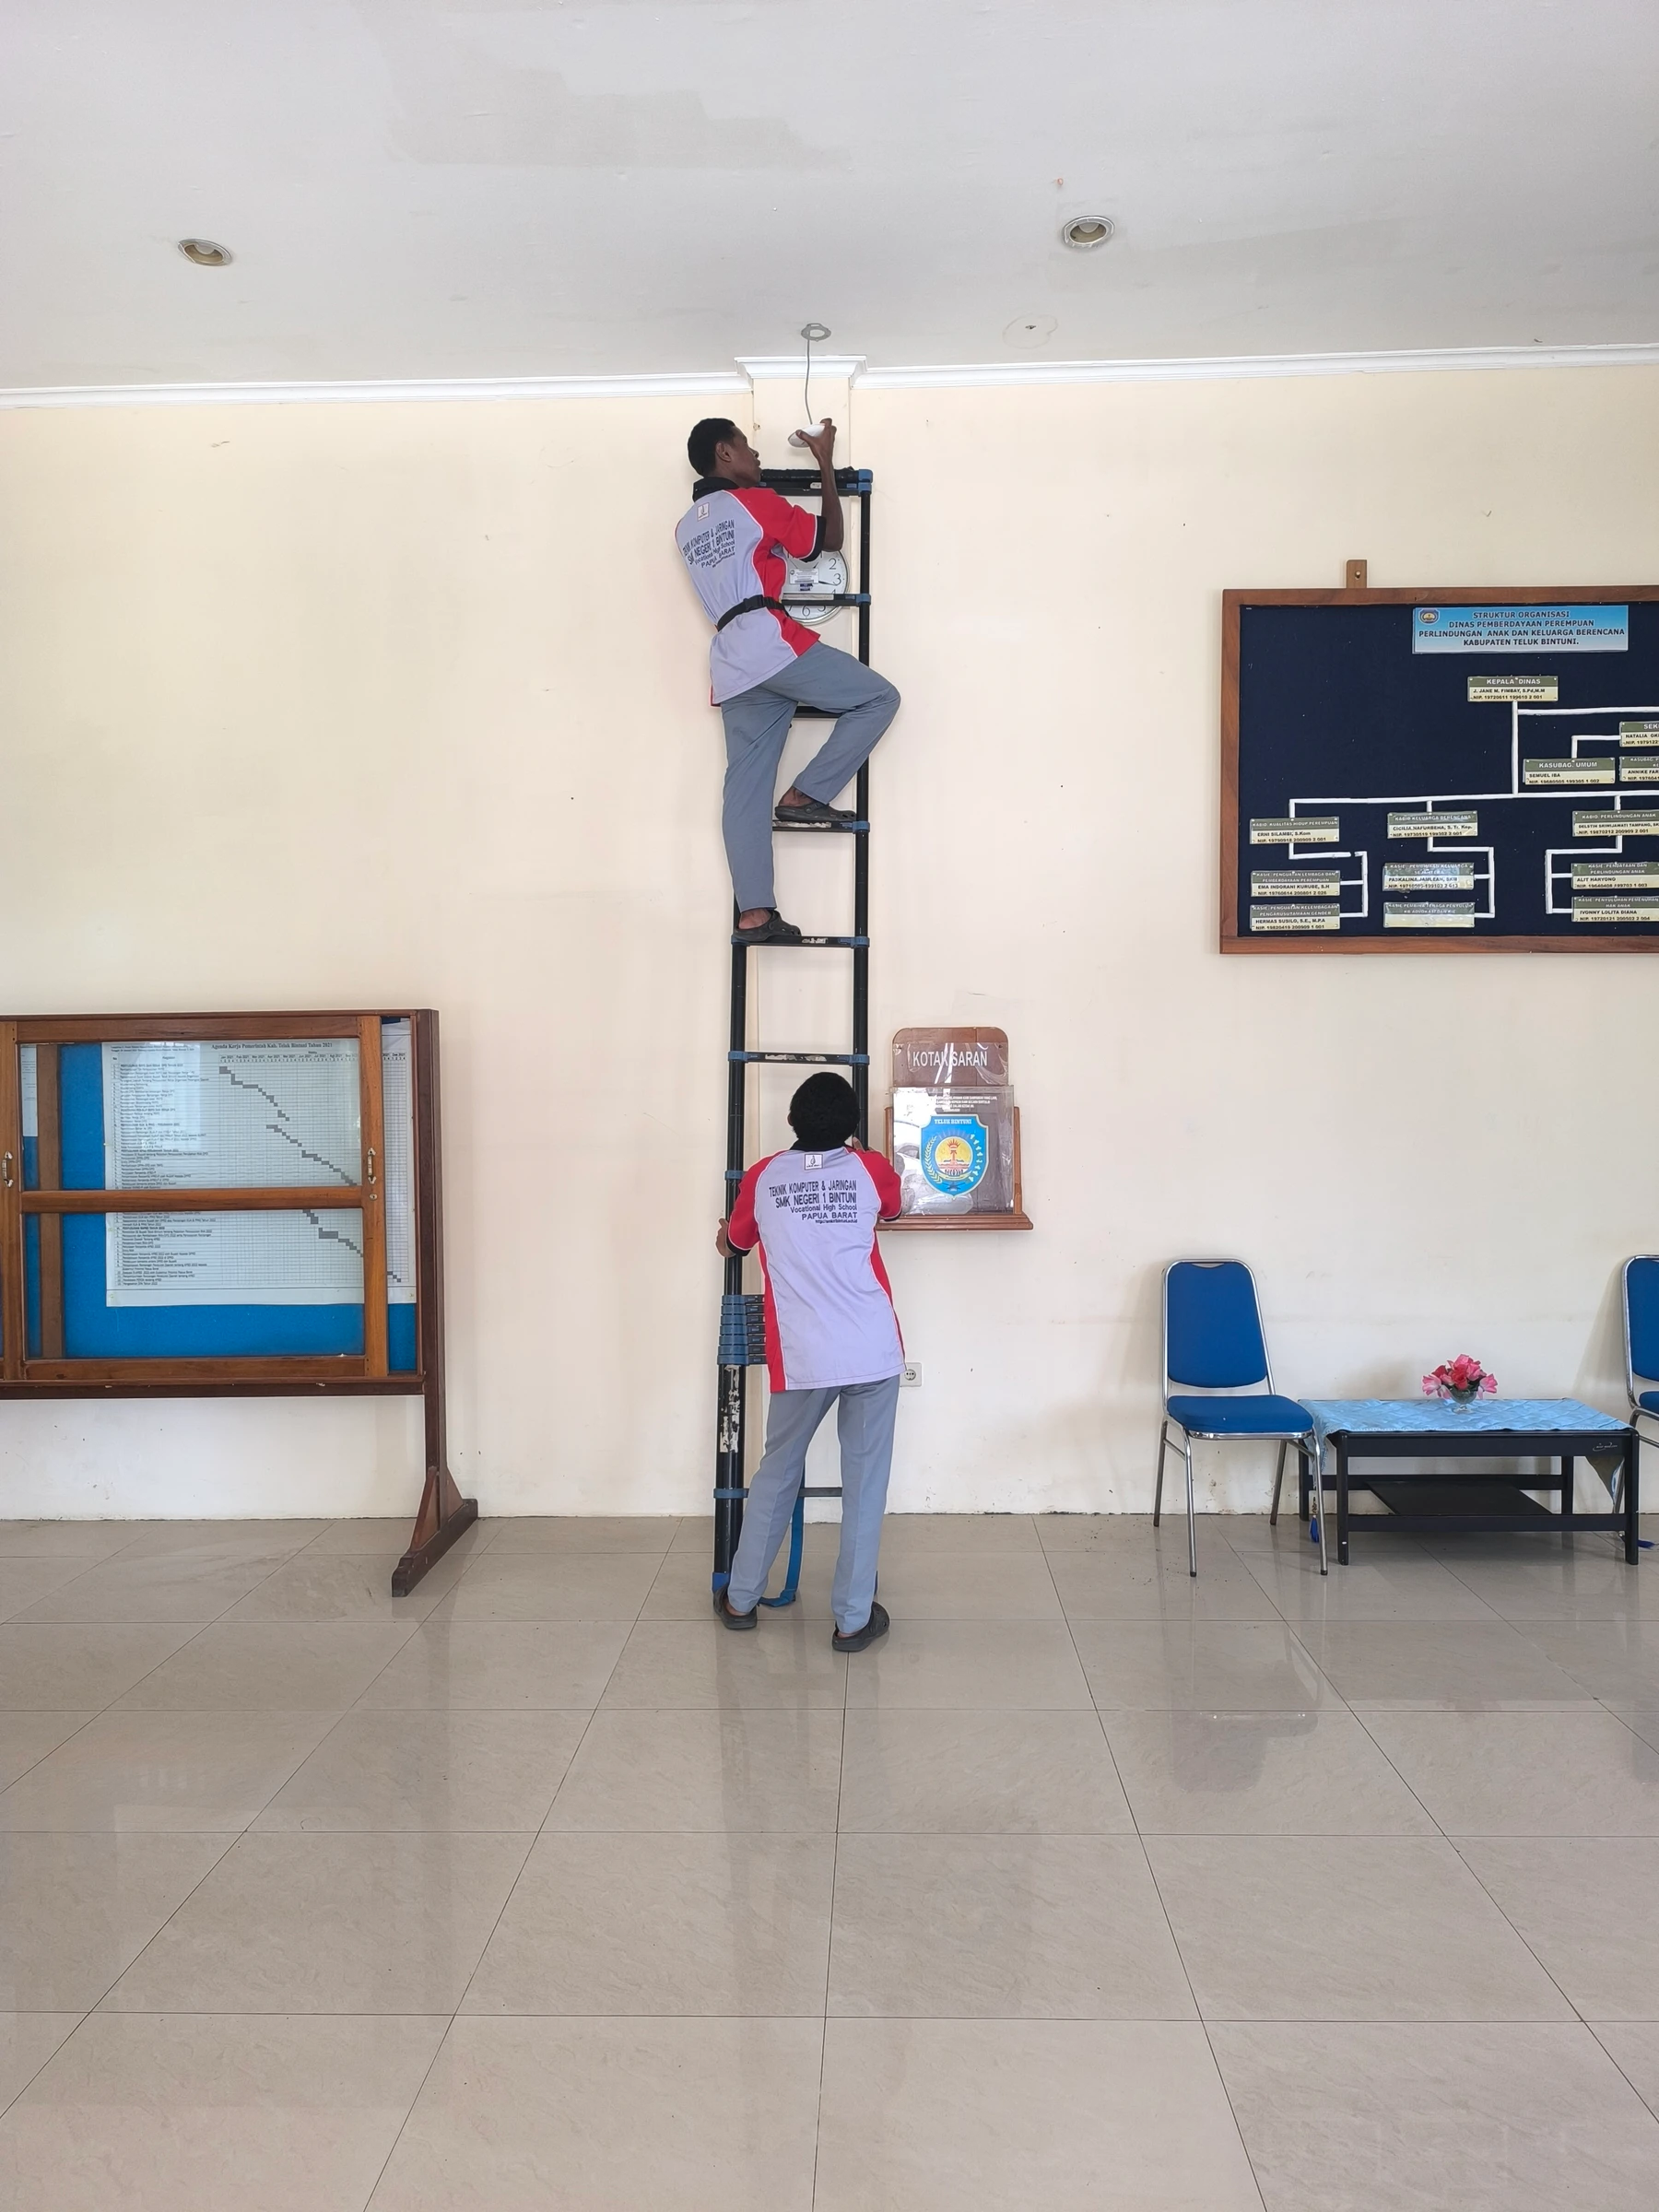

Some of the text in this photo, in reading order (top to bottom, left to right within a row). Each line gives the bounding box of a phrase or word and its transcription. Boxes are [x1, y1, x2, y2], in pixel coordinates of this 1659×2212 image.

[716, 530, 734, 546] BINTUNI
[721, 539, 735, 549] School
[719, 546, 735, 558] BARAT
[829, 558, 837, 570] 2
[833, 573, 842, 586] 3
[802, 605, 810, 616] 6
[913, 1051, 987, 1066] KOTAK SARAN
[769, 1180, 857, 1198] TEKNIK KOMPUTER & JARINGAN
[776, 1192, 857, 1209] SMK NEGERI 1 BINTUNI
[790, 1204, 820, 1213] Vocational
[802, 1212, 828, 1220] PAPUA
